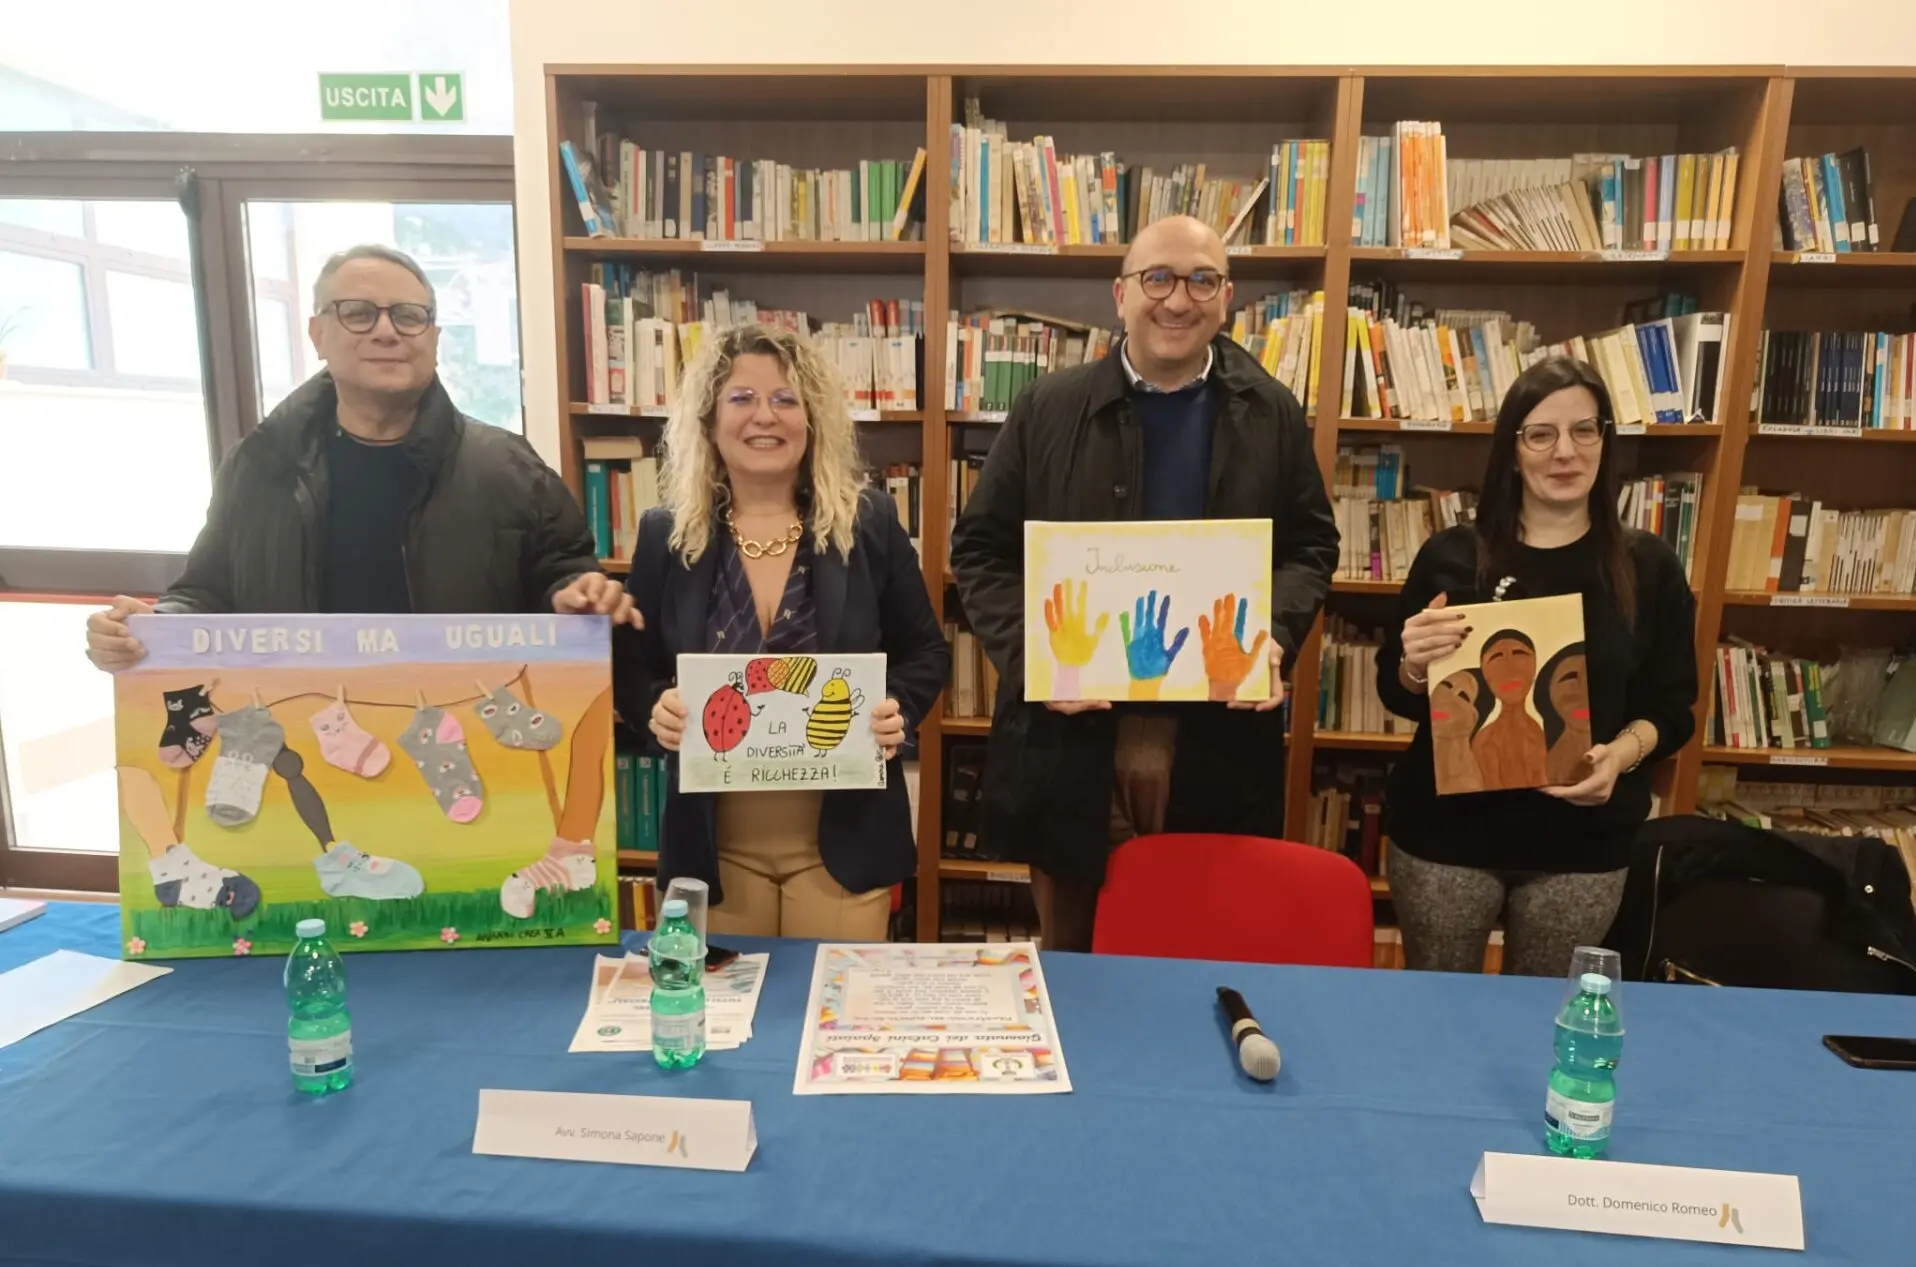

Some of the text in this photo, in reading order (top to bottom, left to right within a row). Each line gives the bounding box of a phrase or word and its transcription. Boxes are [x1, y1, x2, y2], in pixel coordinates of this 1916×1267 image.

[325, 86, 408, 108] USCITA
[1085, 546, 1181, 575] Inclusione
[191, 621, 557, 654] DIVERSI MA UGUALI
[768, 721, 788, 735] LA
[746, 743, 806, 759] DIVERSITÀ
[751, 764, 837, 783] RICCHEZZA!
[580, 1127, 622, 1141] Simona
[624, 1129, 666, 1144] Sapone
[1567, 1193, 1718, 1217] Dott. Domenico Romeo
